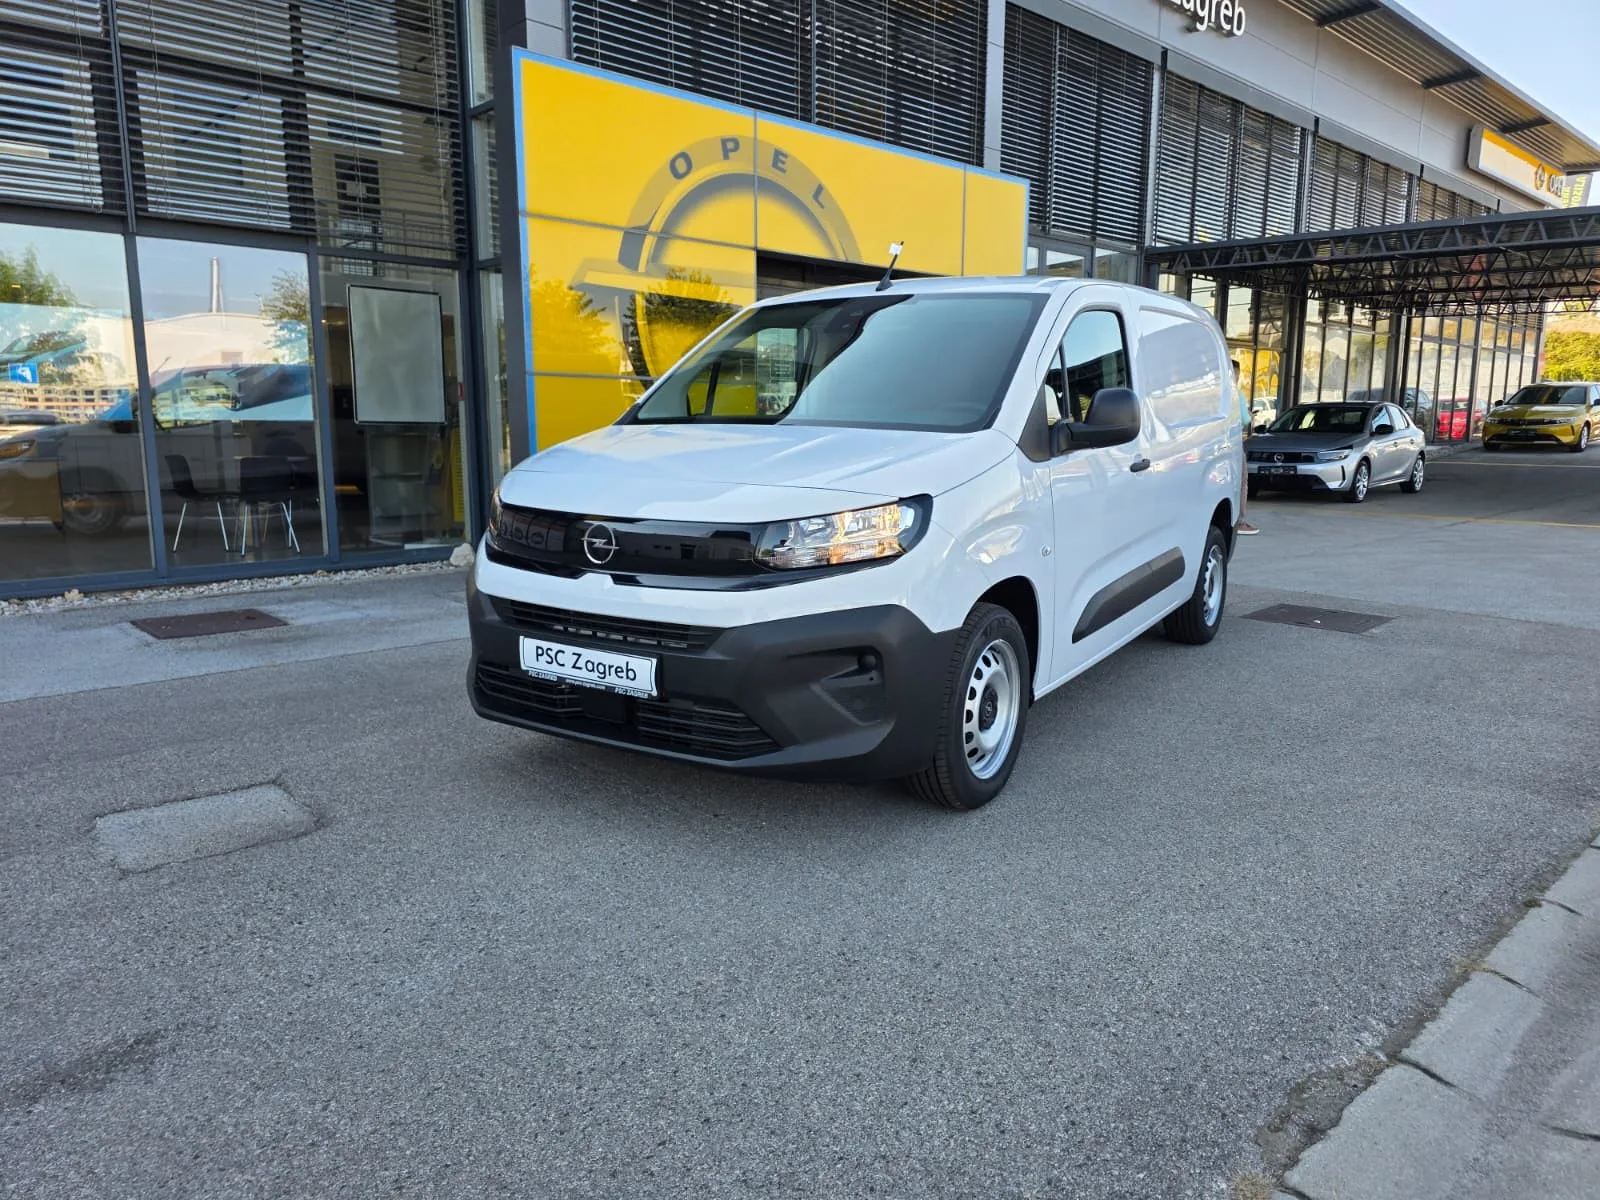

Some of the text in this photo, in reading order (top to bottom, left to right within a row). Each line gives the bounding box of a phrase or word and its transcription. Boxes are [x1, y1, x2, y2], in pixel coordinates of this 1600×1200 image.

[1170, 0, 1246, 36] greb
[669, 137, 825, 209] OPEL
[535, 645, 638, 682] PSC Zagreb
